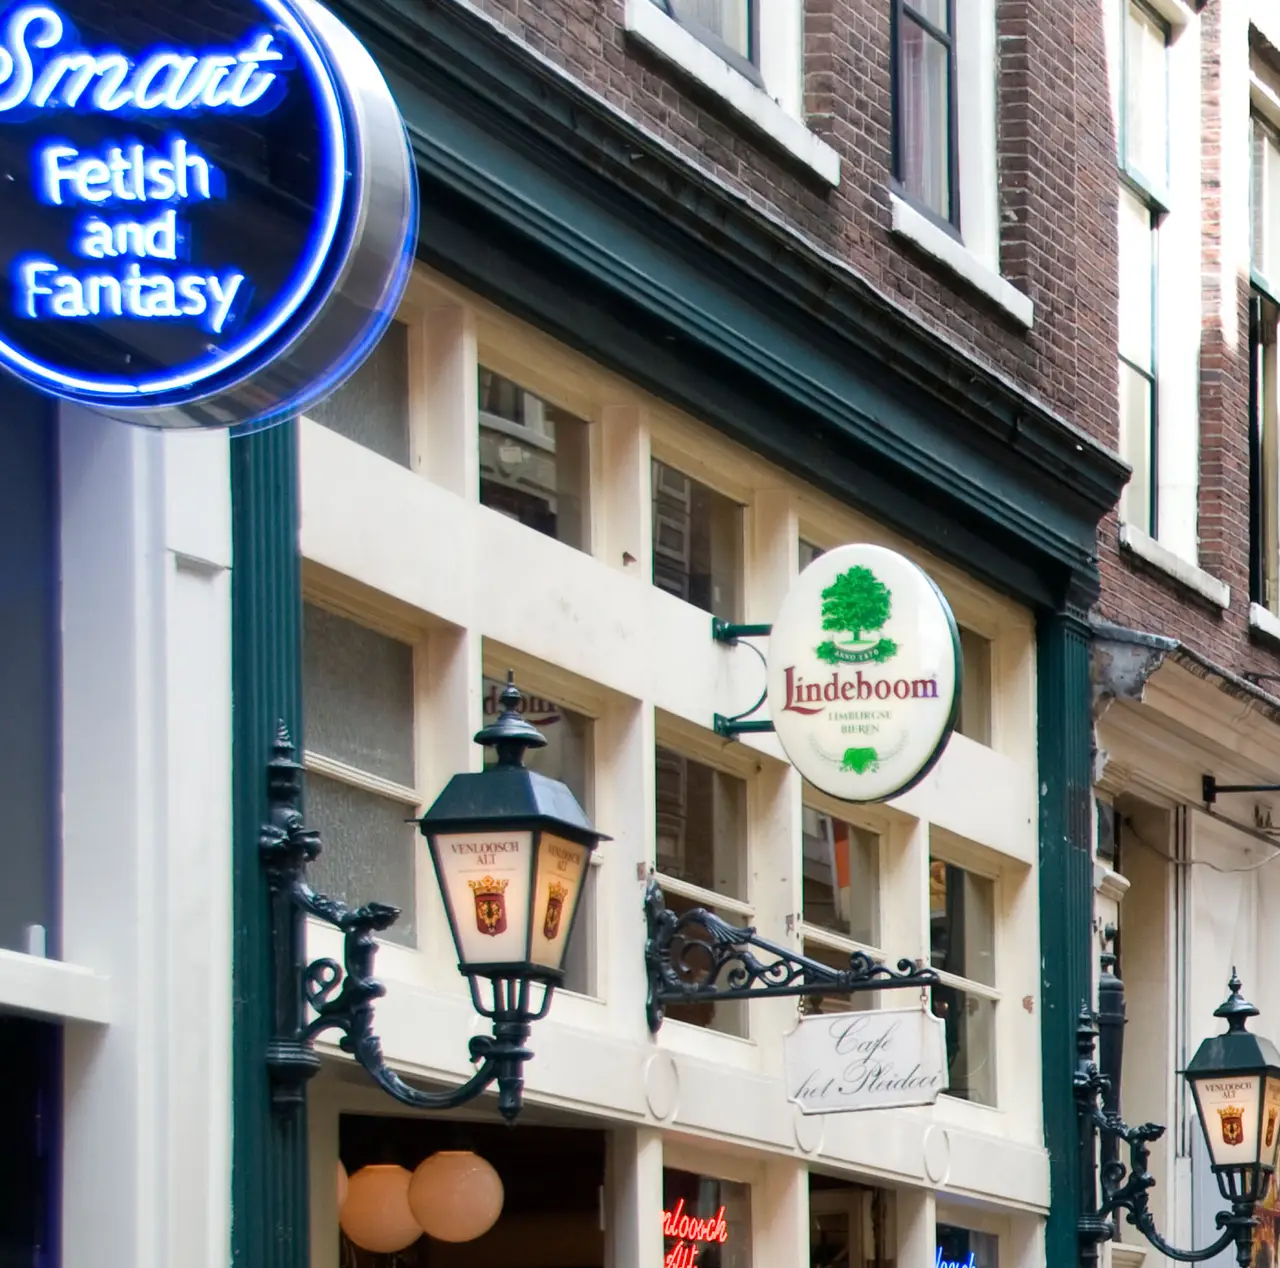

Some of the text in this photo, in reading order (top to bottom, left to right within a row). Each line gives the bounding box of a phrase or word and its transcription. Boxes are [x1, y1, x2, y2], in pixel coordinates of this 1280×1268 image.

[0, 7, 283, 112] Smart
[83, 209, 176, 260] and
[23, 262, 245, 333] Fantasy
[781, 666, 939, 715] Lindeboom
[451, 841, 519, 854] VENLOOSCH
[476, 854, 498, 866] ALT
